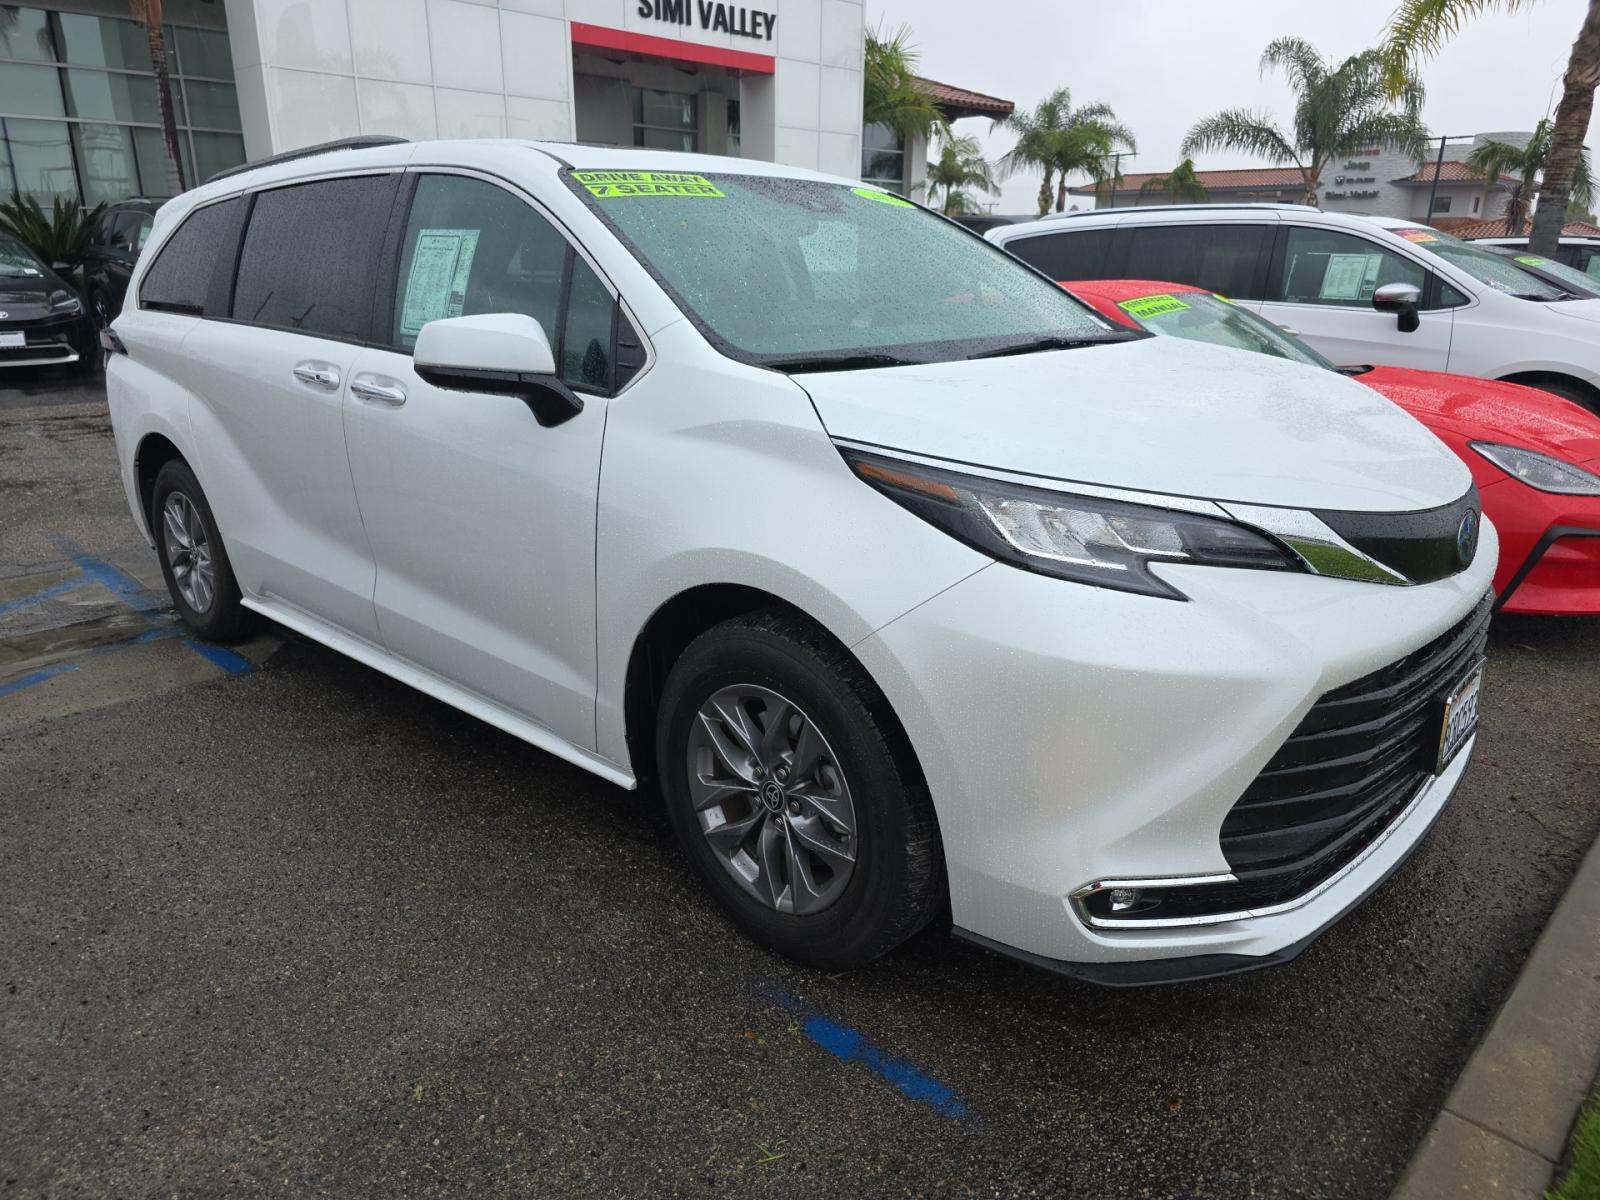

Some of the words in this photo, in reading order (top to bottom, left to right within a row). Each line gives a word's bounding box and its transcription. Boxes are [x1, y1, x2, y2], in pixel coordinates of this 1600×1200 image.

[638, 0, 692, 26] SIMI
[699, 0, 776, 41] VALLEY
[579, 172, 645, 183] DRIVE
[650, 173, 703, 184] AWAY
[595, 184, 610, 196] 7
[616, 184, 718, 195] SEATER
